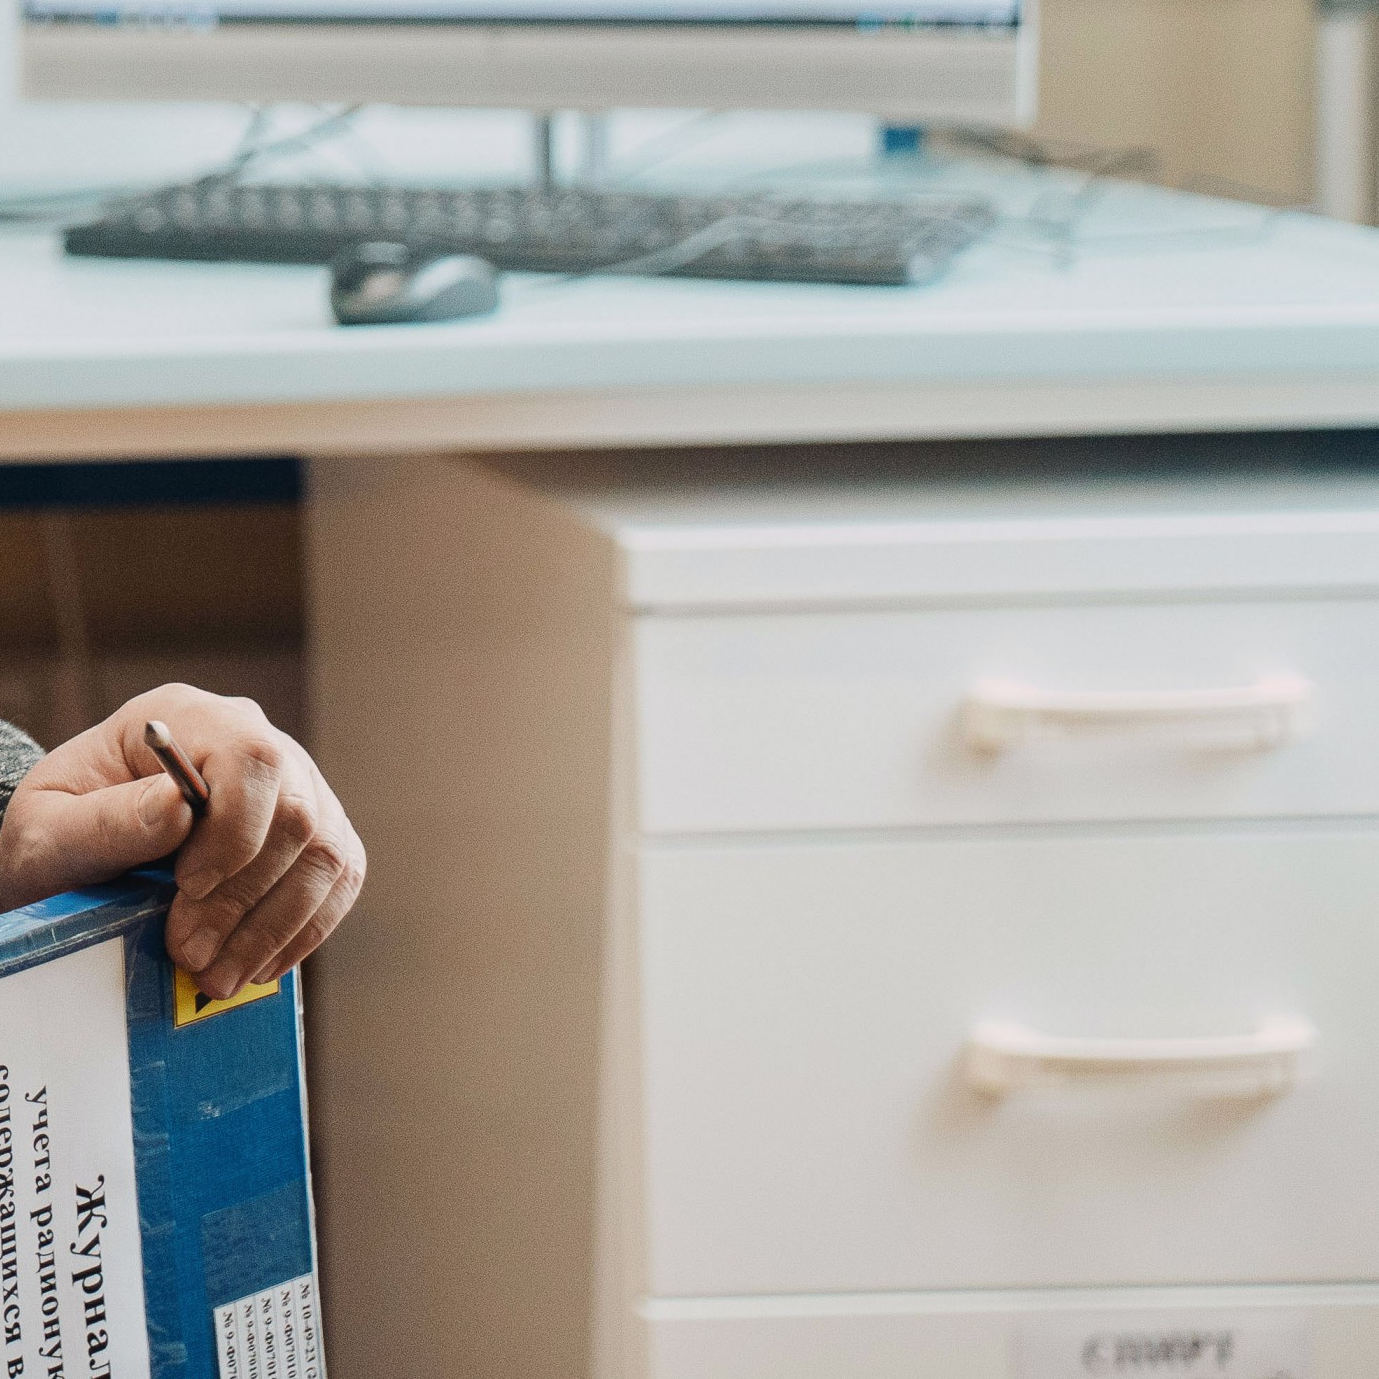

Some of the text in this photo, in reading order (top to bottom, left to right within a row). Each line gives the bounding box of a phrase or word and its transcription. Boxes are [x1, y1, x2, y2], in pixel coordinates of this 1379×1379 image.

[25, 1085, 52, 1195] учета
[70, 1174, 112, 1379] Журнал
[7, 1355, 24, 1379] в
